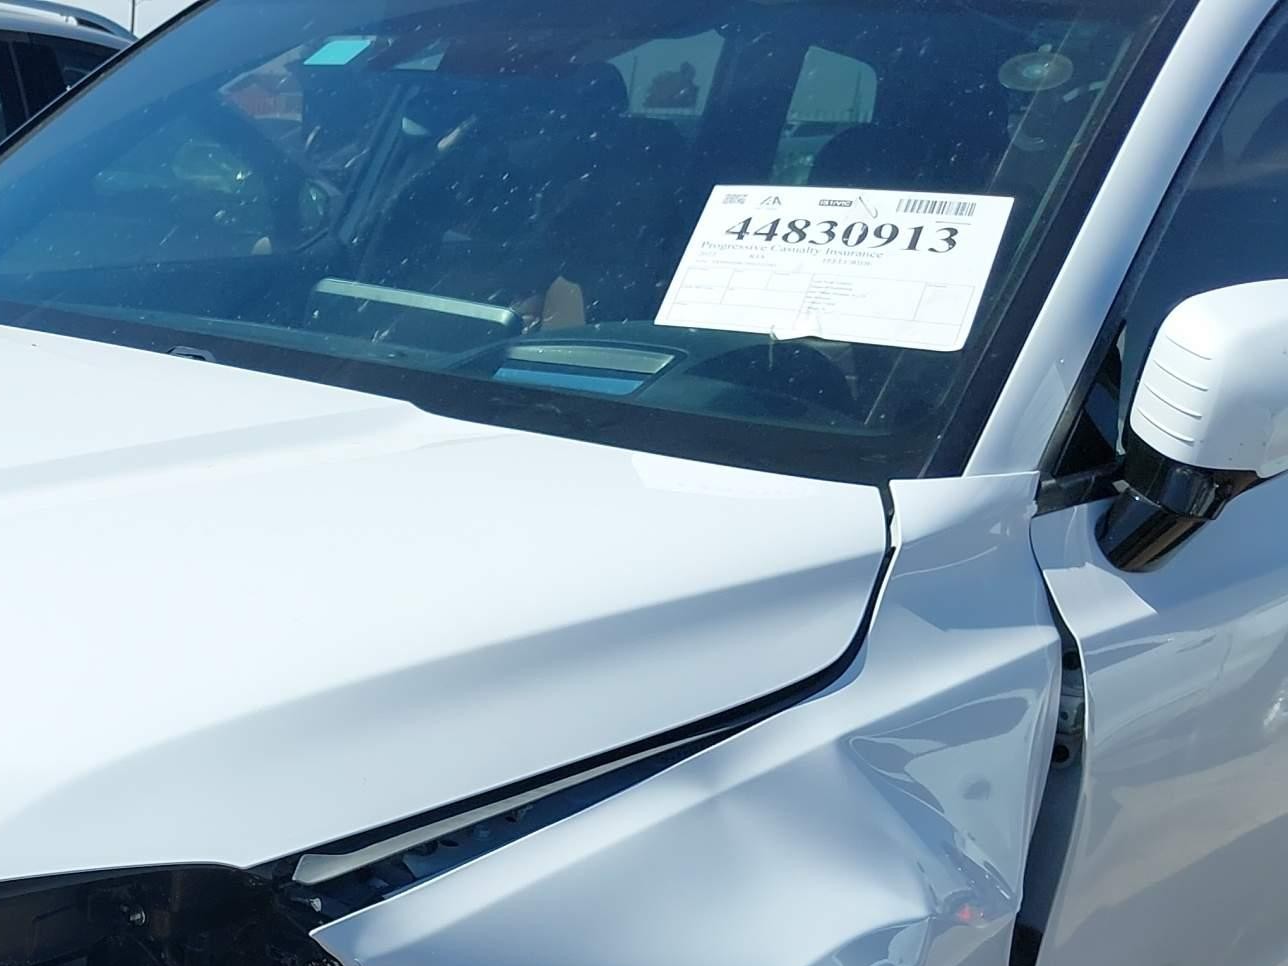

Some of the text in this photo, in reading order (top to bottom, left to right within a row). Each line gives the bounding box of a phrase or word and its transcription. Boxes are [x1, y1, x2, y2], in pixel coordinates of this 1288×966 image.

[724, 216, 959, 254] 44830913
[701, 241, 884, 259] Progressive Casualty Insurance
